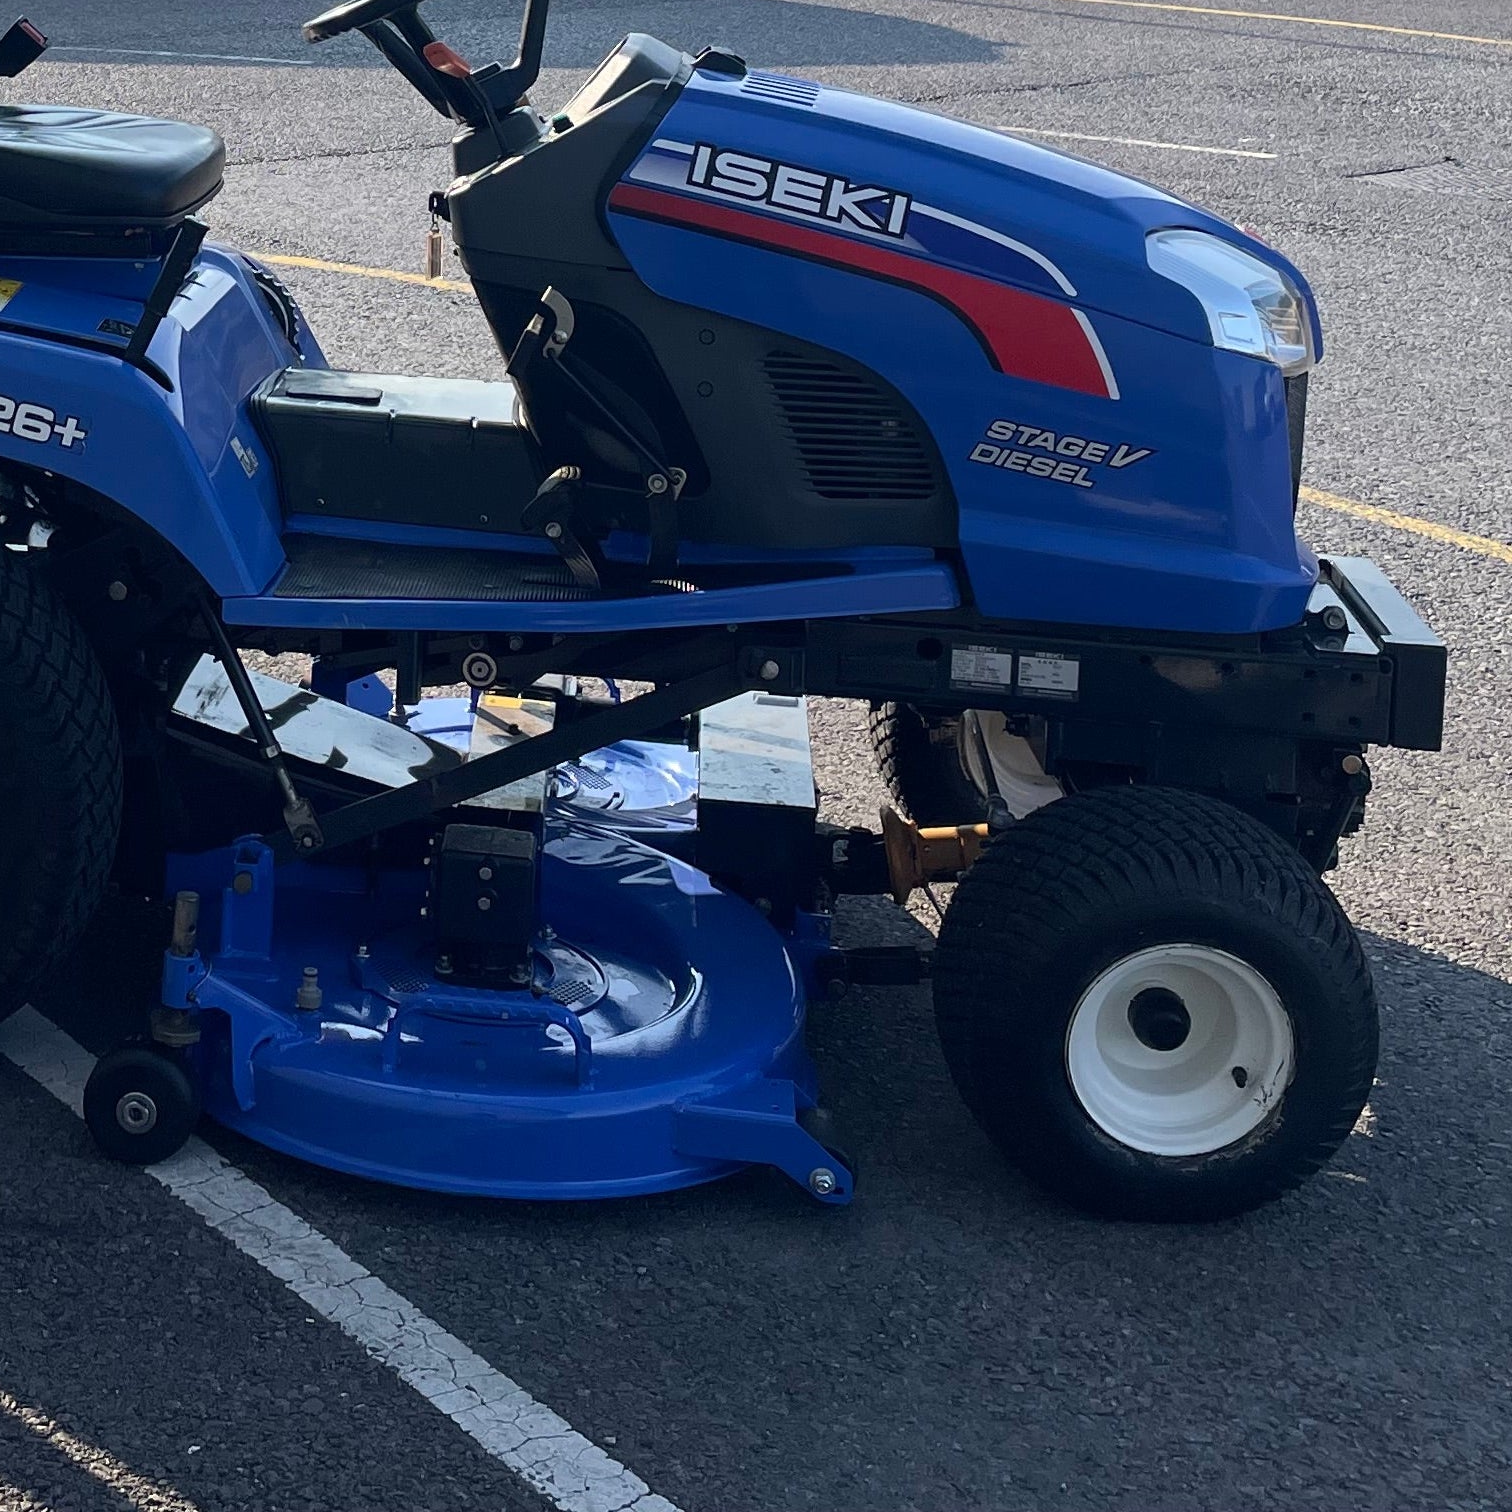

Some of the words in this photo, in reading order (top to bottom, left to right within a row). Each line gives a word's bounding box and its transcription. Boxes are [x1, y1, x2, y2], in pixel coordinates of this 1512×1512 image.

[690, 143, 910, 237] ISEKI
[971, 441, 1094, 488] DIESEL
[986, 420, 1109, 460] STAGE
[1109, 444, 1155, 471] V
